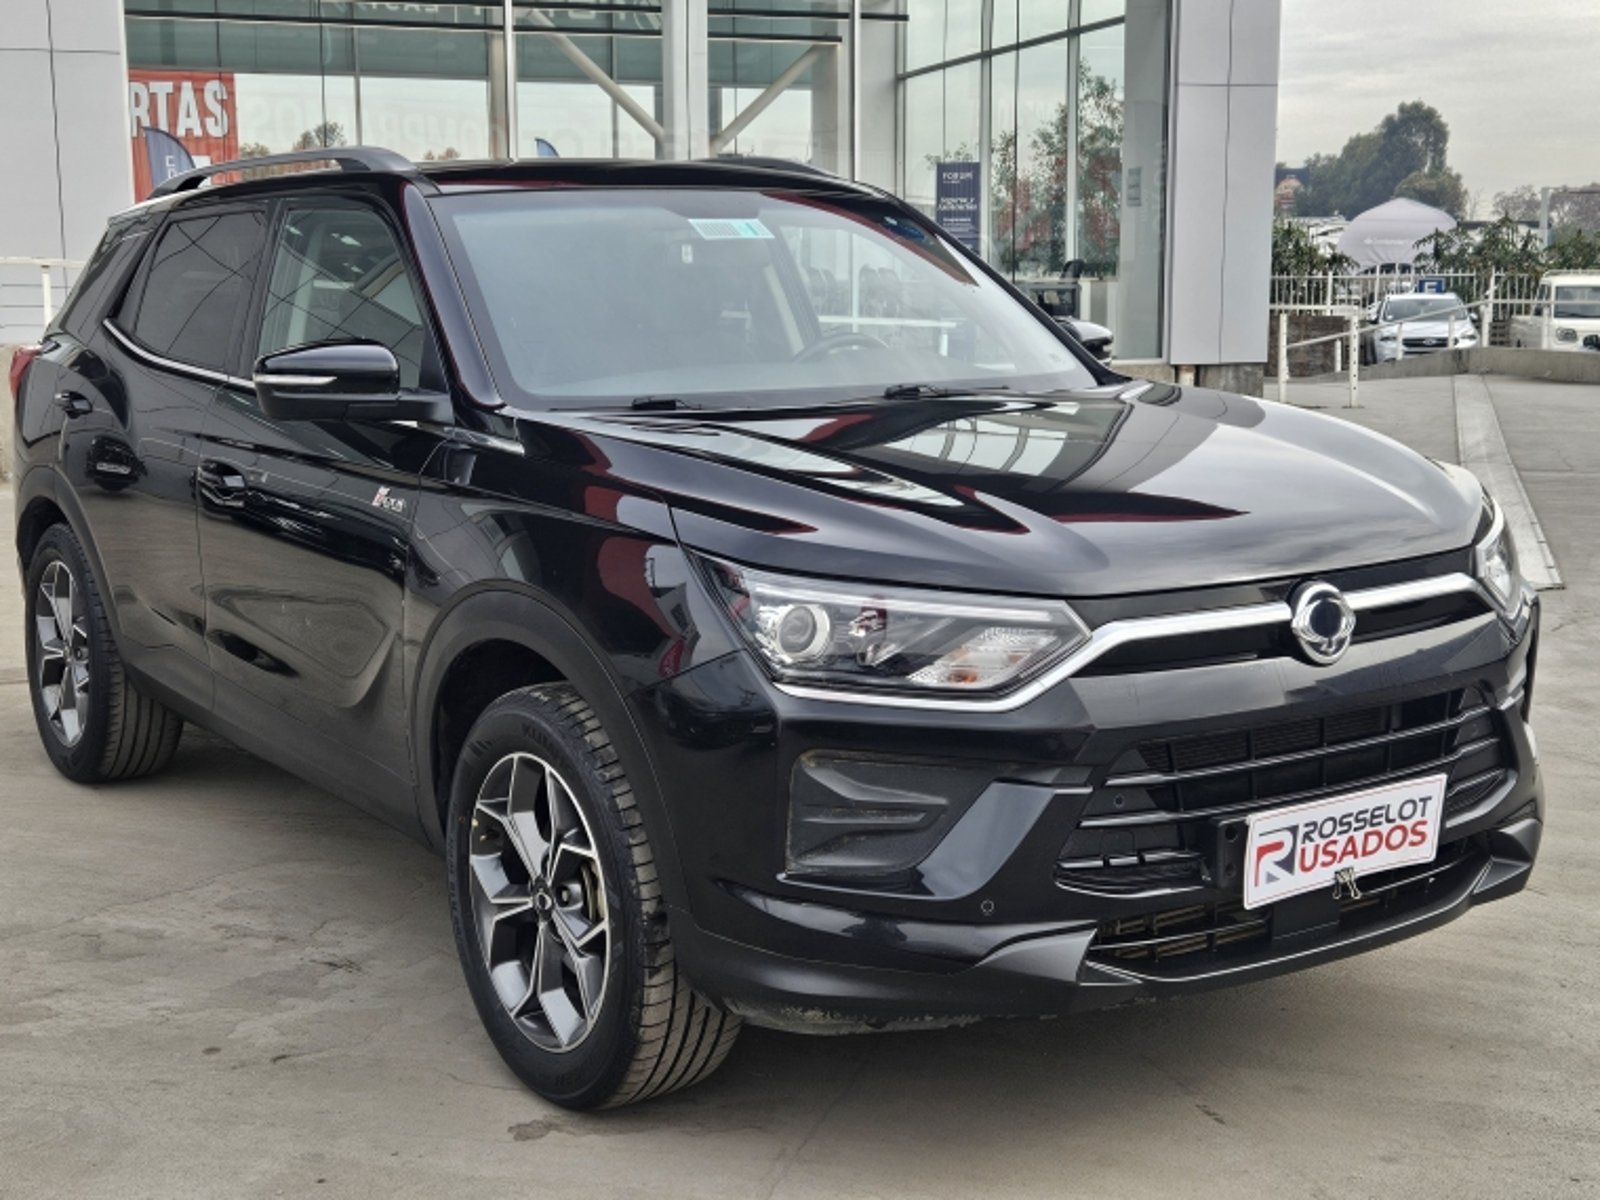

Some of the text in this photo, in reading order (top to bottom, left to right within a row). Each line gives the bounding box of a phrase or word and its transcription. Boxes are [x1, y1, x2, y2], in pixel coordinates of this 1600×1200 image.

[129, 80, 229, 138] RTAS
[1300, 820, 1428, 872] USADOS
[1302, 796, 1432, 844] ROSSELOT
